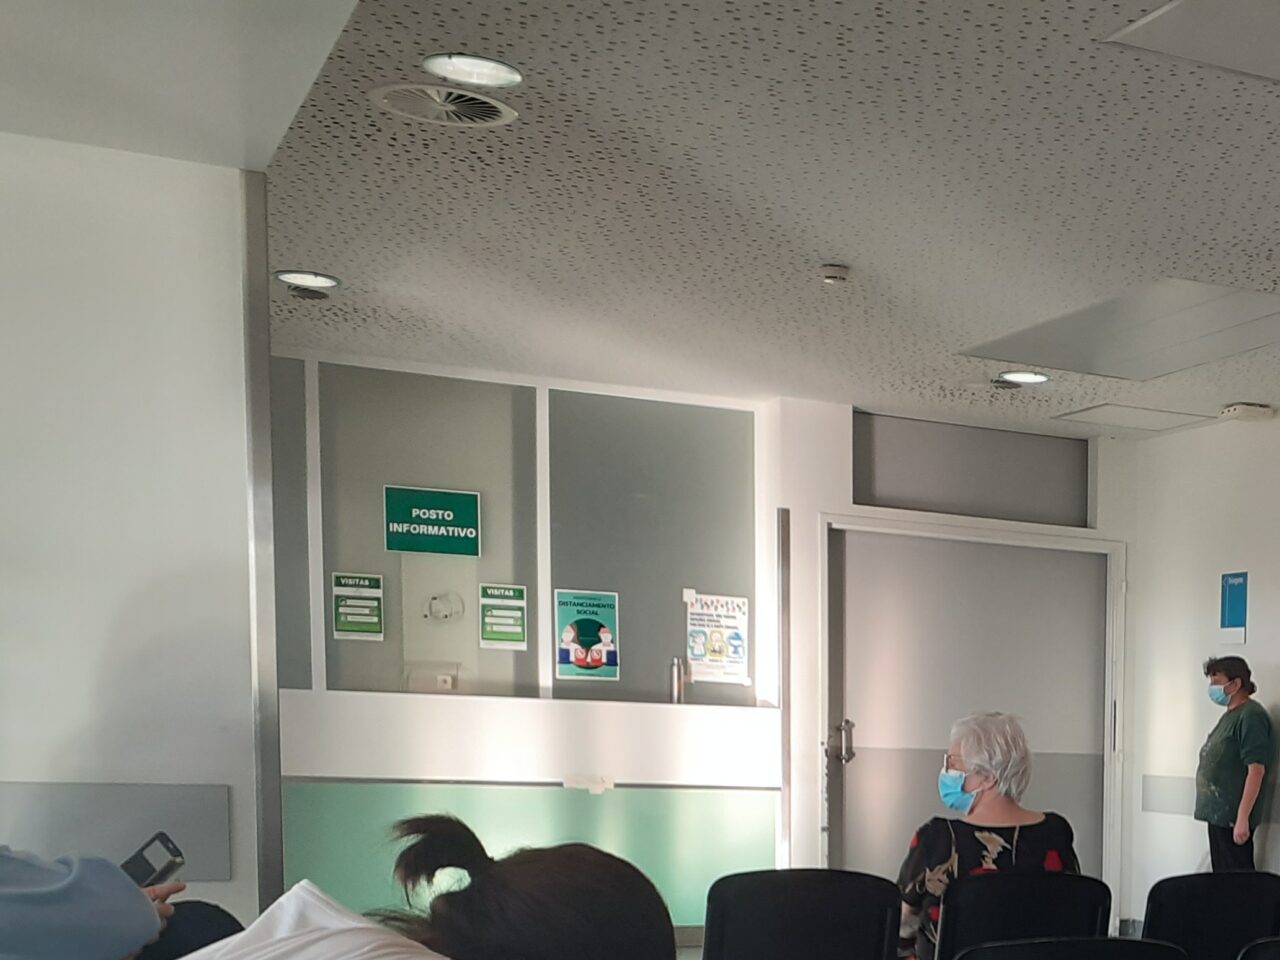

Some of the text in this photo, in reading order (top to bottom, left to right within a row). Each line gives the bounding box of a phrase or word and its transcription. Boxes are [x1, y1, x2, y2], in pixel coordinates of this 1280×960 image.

[411, 507, 454, 521] POSTO
[389, 522, 477, 538] INFORMATIVO
[340, 577, 370, 586] VISITAS
[486, 588, 514, 597] VISITAS
[558, 600, 616, 610] DISTANCIAMENTO
